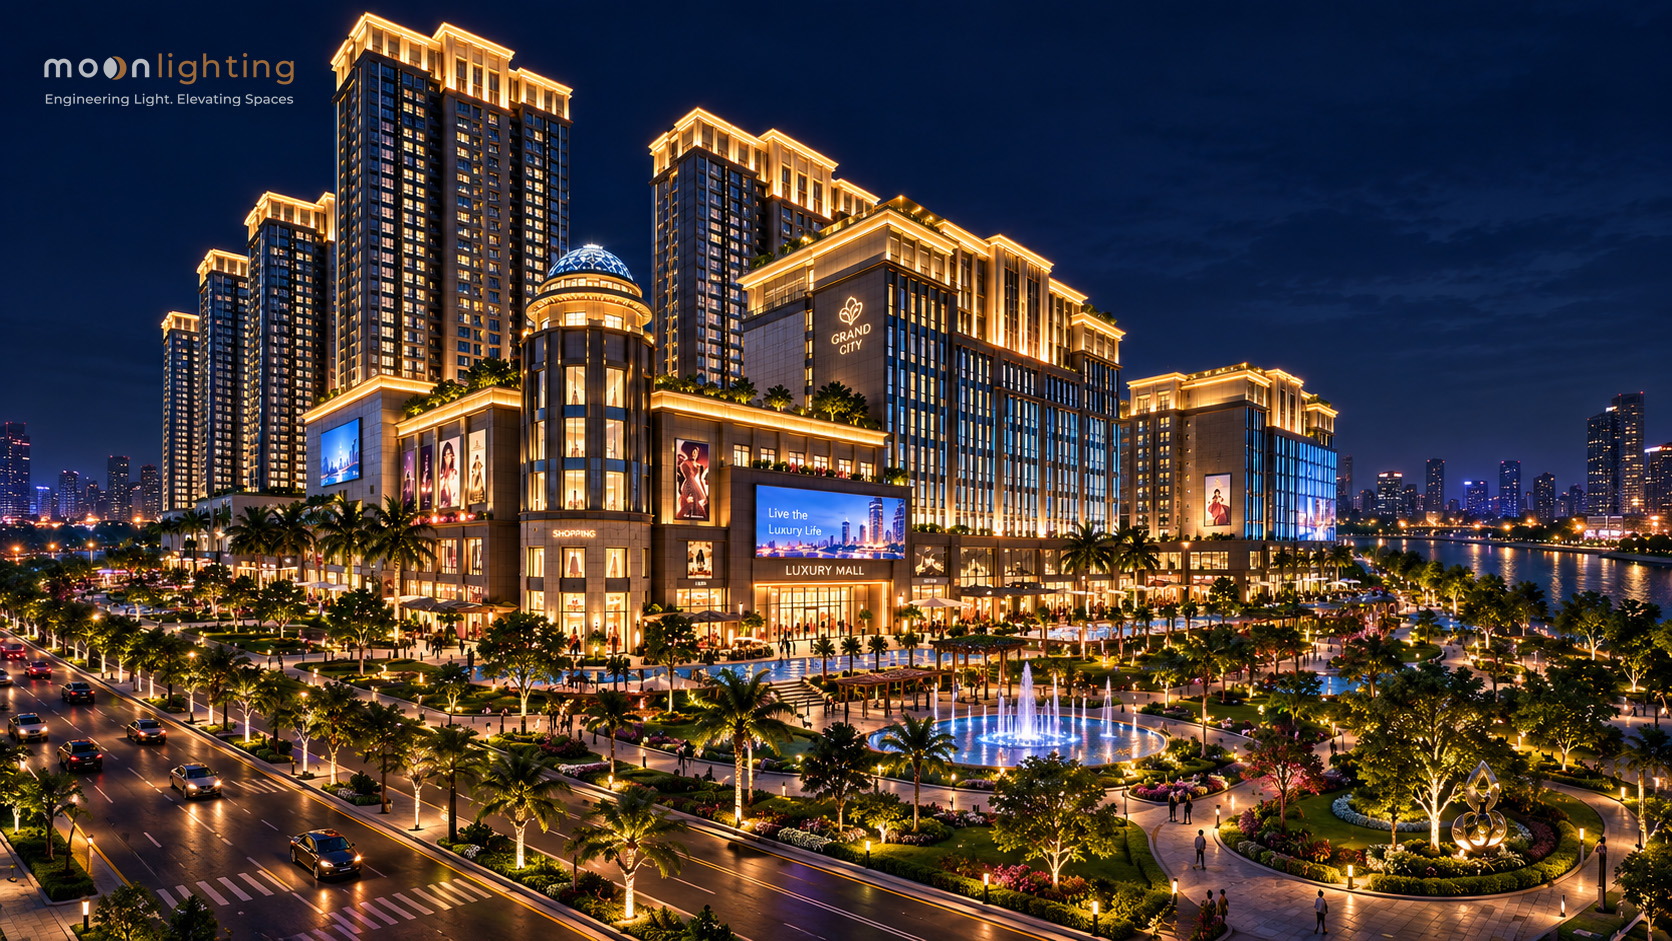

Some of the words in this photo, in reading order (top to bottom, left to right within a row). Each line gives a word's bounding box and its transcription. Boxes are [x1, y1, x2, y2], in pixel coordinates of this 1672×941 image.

[831, 323, 871, 345] GRAND
[839, 339, 862, 355] CITY
[768, 508, 789, 519] Live
[792, 509, 808, 520] the
[552, 529, 597, 538] SHOPPING
[768, 524, 802, 537] Luxury
[805, 525, 822, 536] Life
[785, 565, 832, 576] LUXURY
[836, 566, 865, 576] MALL
